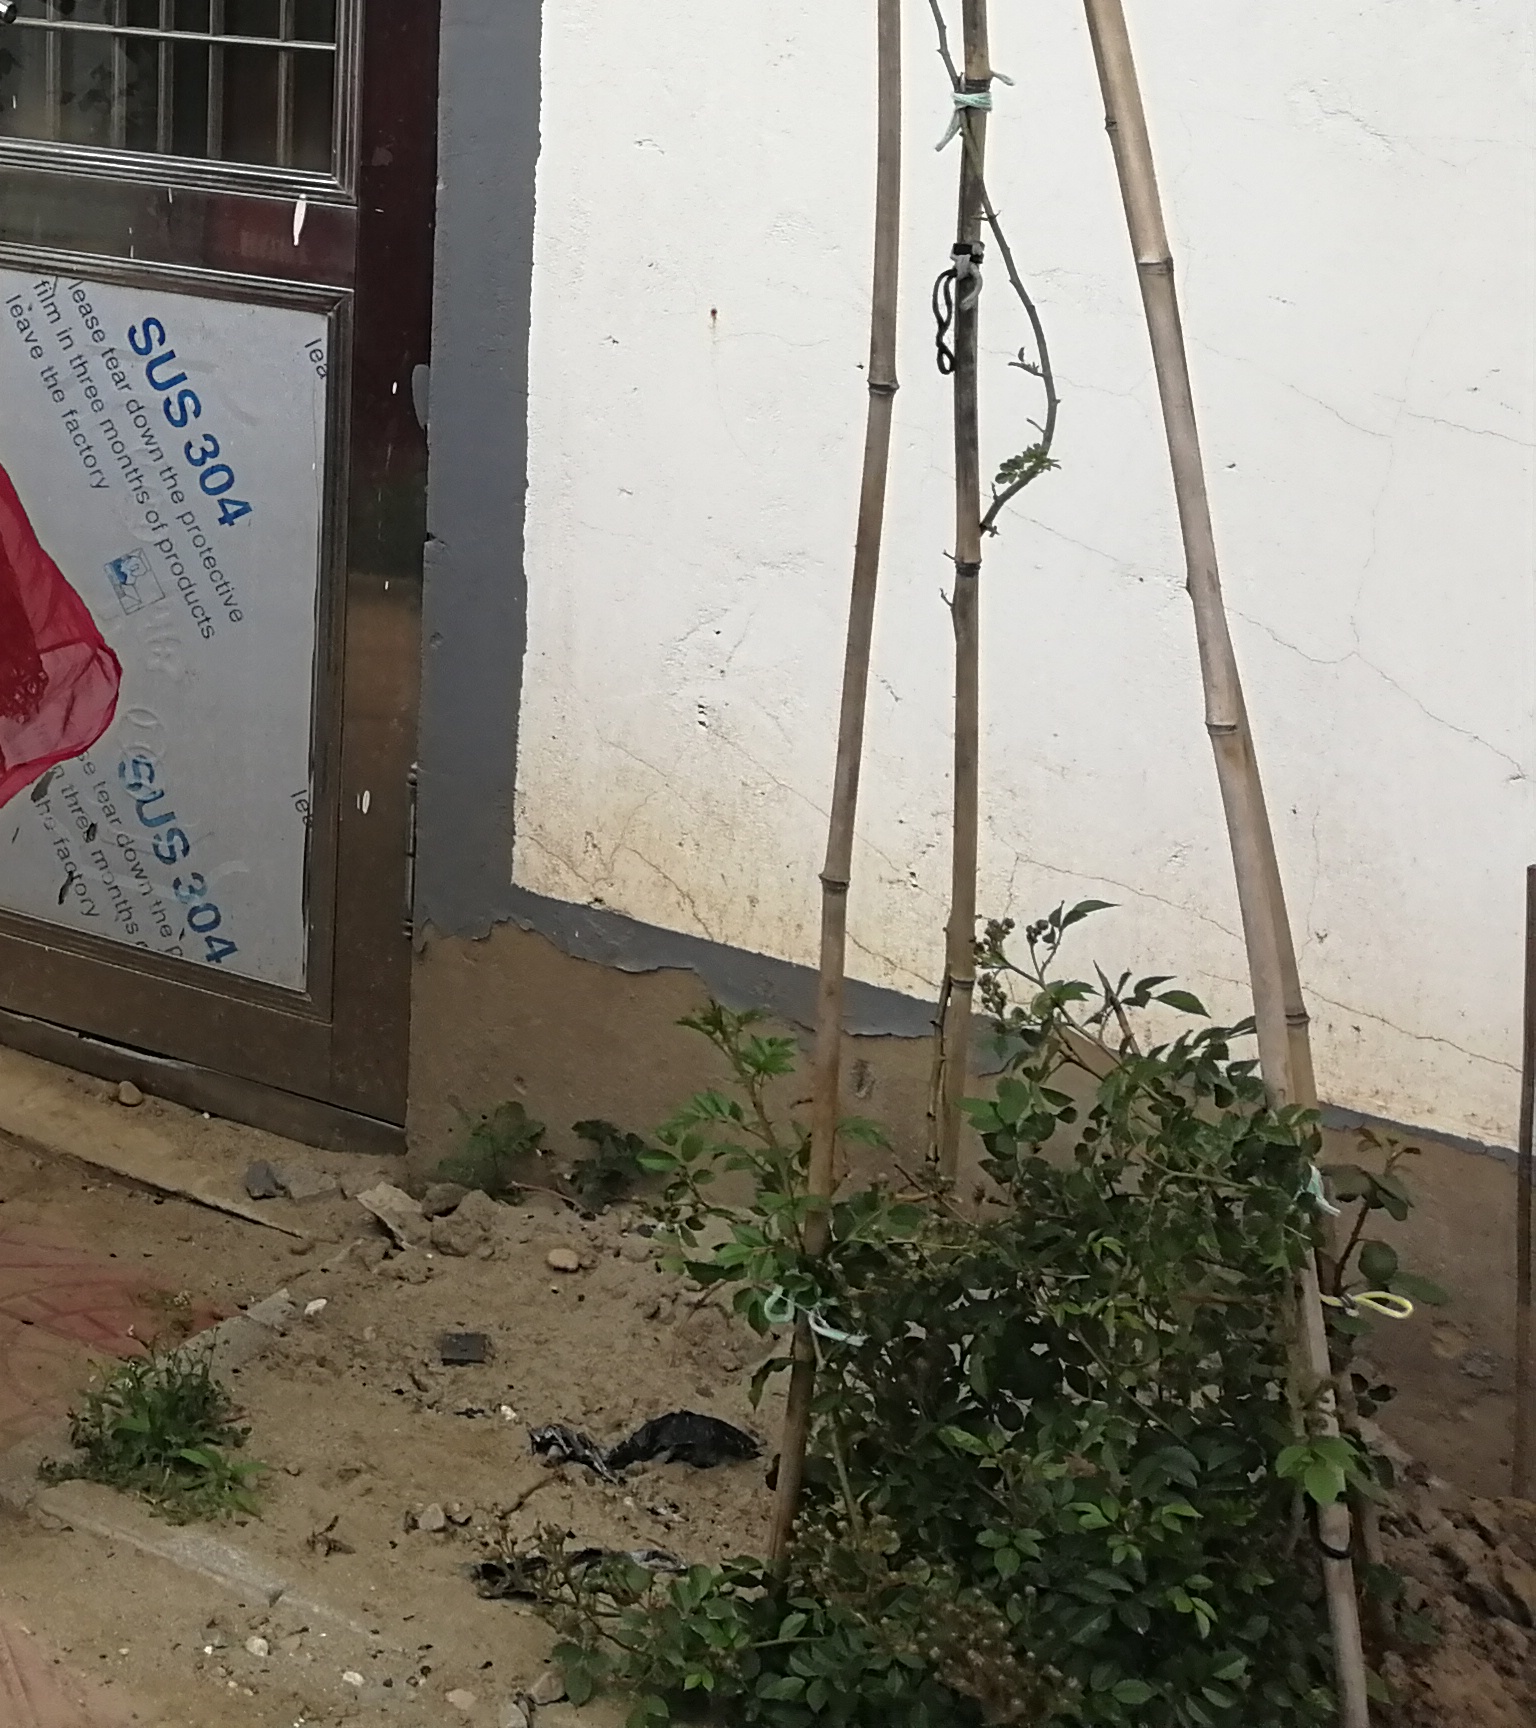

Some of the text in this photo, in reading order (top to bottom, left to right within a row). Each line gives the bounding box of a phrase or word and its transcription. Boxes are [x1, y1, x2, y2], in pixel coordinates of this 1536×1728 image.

[5, 294, 109, 490] leave the factory
[33, 280, 216, 639] film in three months of products
[101, 347, 132, 391] tear
[125, 399, 164, 462] down
[159, 466, 184, 504] the
[176, 511, 244, 623] protective
[128, 317, 253, 527] SUS 304
[91, 849, 139, 934] months
[116, 834, 153, 896] down
[150, 899, 173, 937] the
[173, 872, 238, 964] 304
